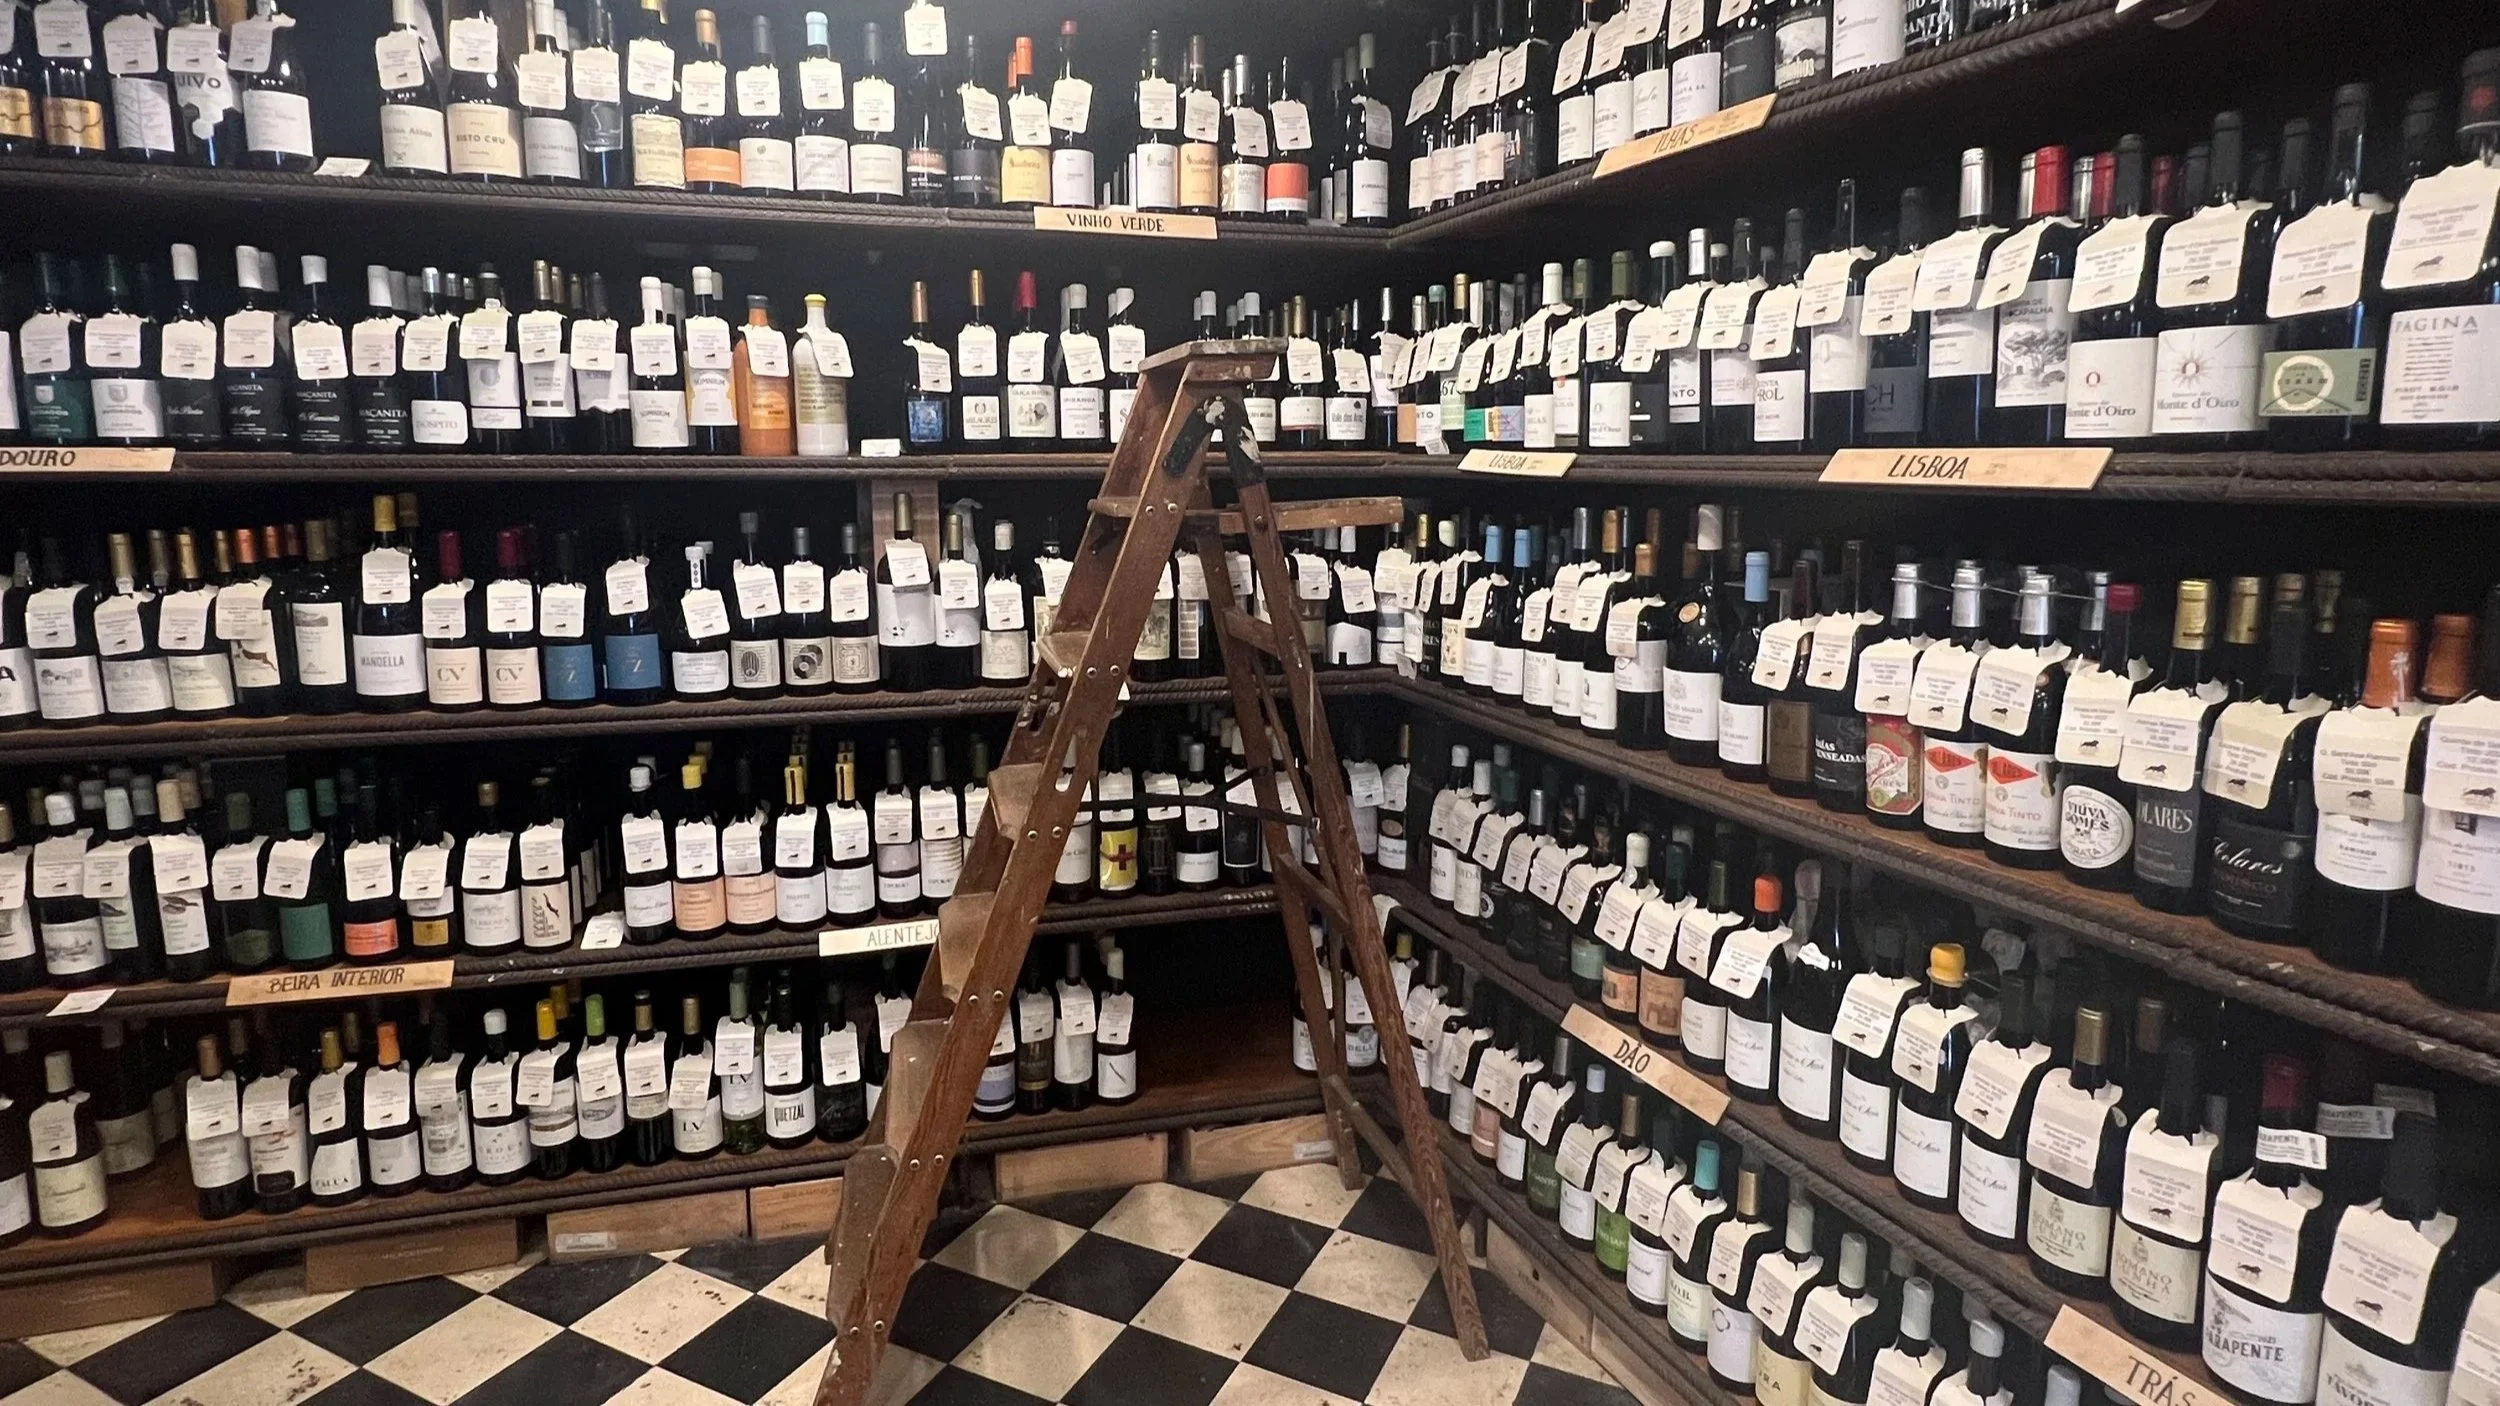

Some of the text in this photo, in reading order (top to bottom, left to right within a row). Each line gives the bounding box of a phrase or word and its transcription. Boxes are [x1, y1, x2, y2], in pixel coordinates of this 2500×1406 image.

[484, 135, 505, 145] CRU
[1653, 122, 1698, 154] ILHAS
[1066, 212, 1165, 233] VINHO VERDE
[2067, 404, 2137, 418] onte d'Oiro
[0, 449, 76, 468] DOURO
[1488, 453, 1526, 471] LISBOA
[1887, 454, 1971, 480] LISBOA
[265, 966, 405, 994] BEIRA INTERIOR
